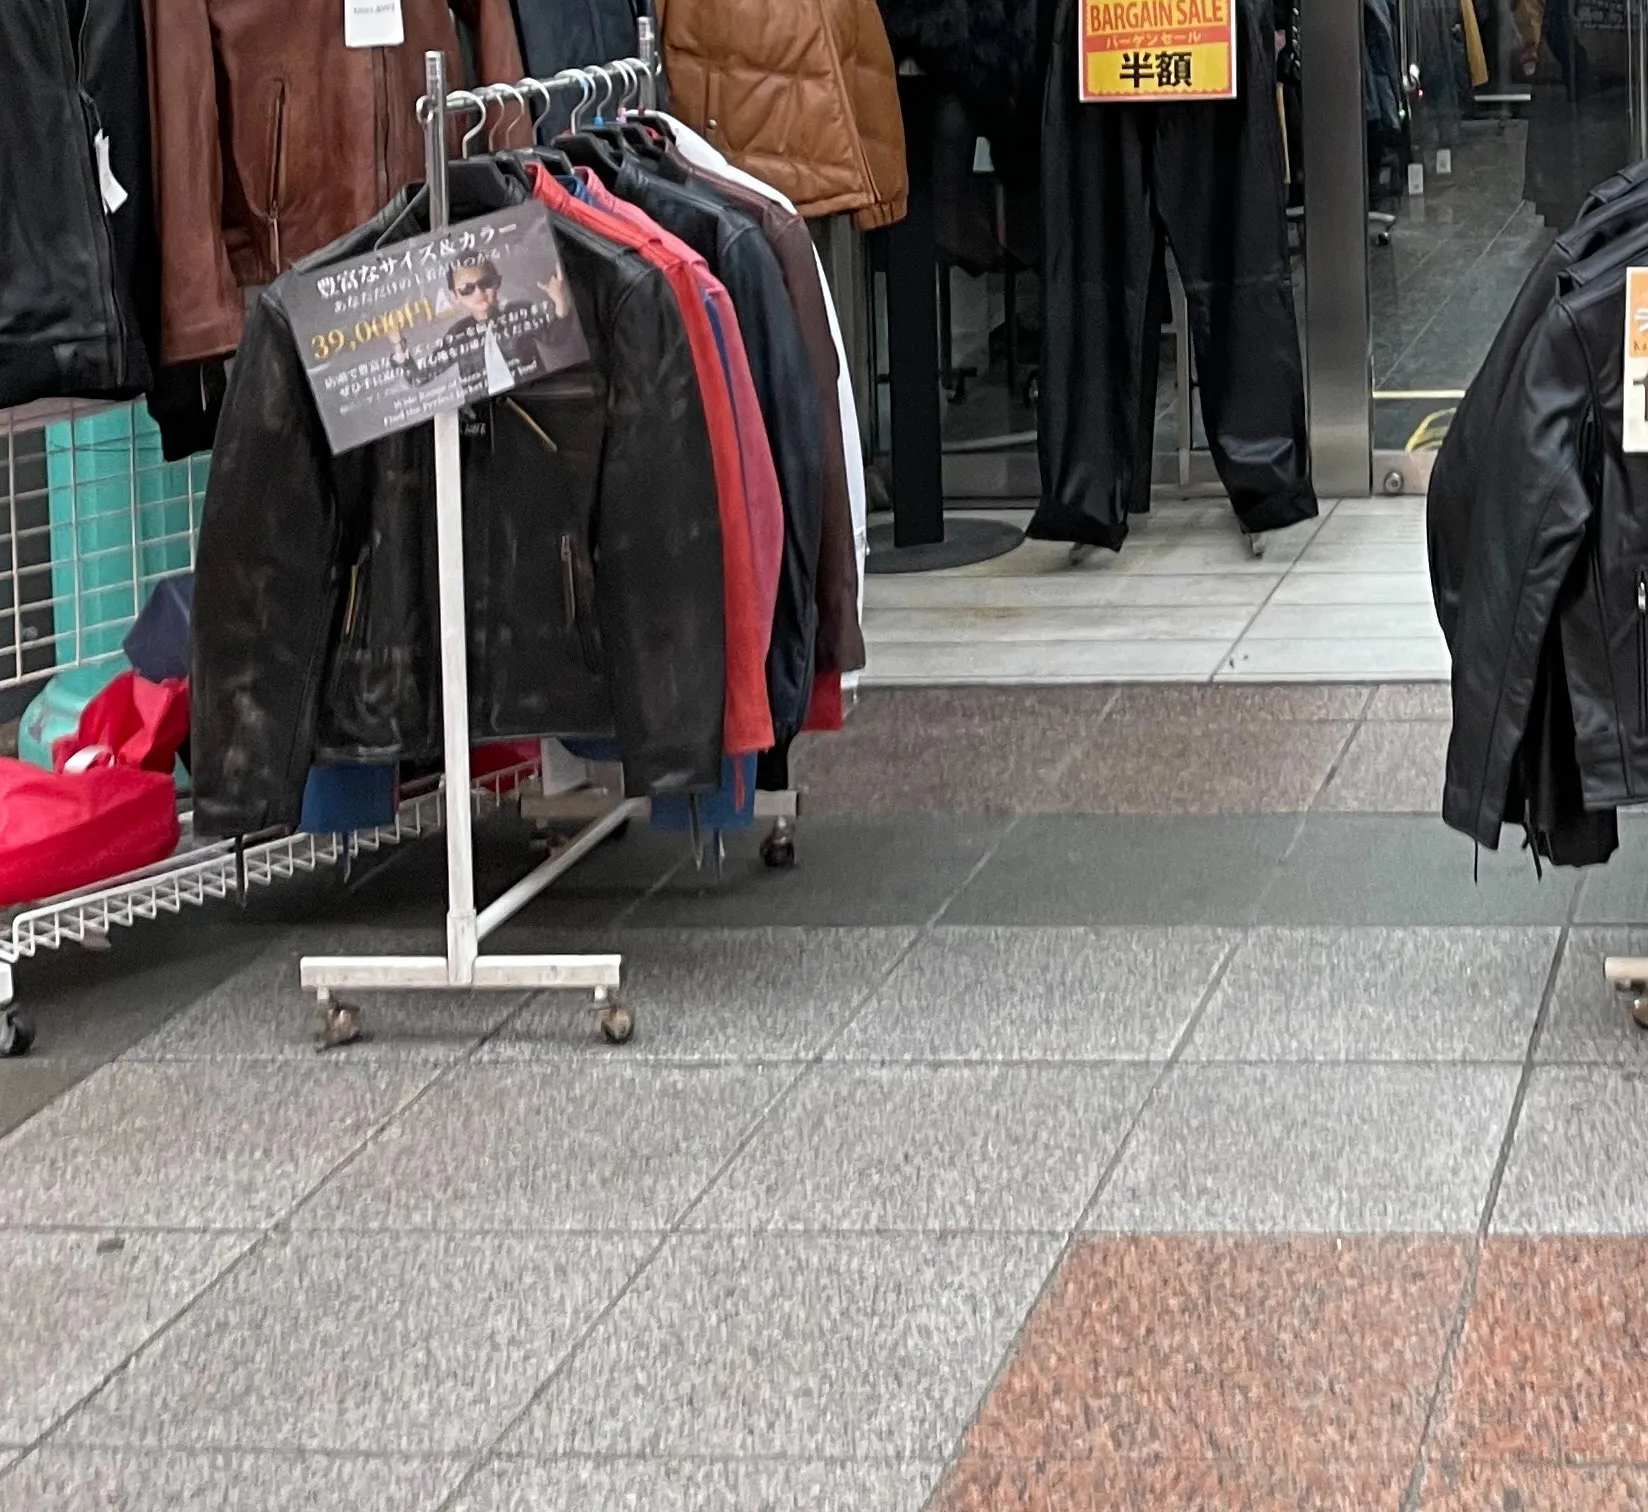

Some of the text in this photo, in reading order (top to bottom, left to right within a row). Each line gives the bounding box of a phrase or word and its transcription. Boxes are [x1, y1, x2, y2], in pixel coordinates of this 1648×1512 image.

[1090, 0, 1174, 33] BARGAIN
[1106, 31, 1202, 50] バーゲンセール
[1119, 51, 1193, 88] 半額
